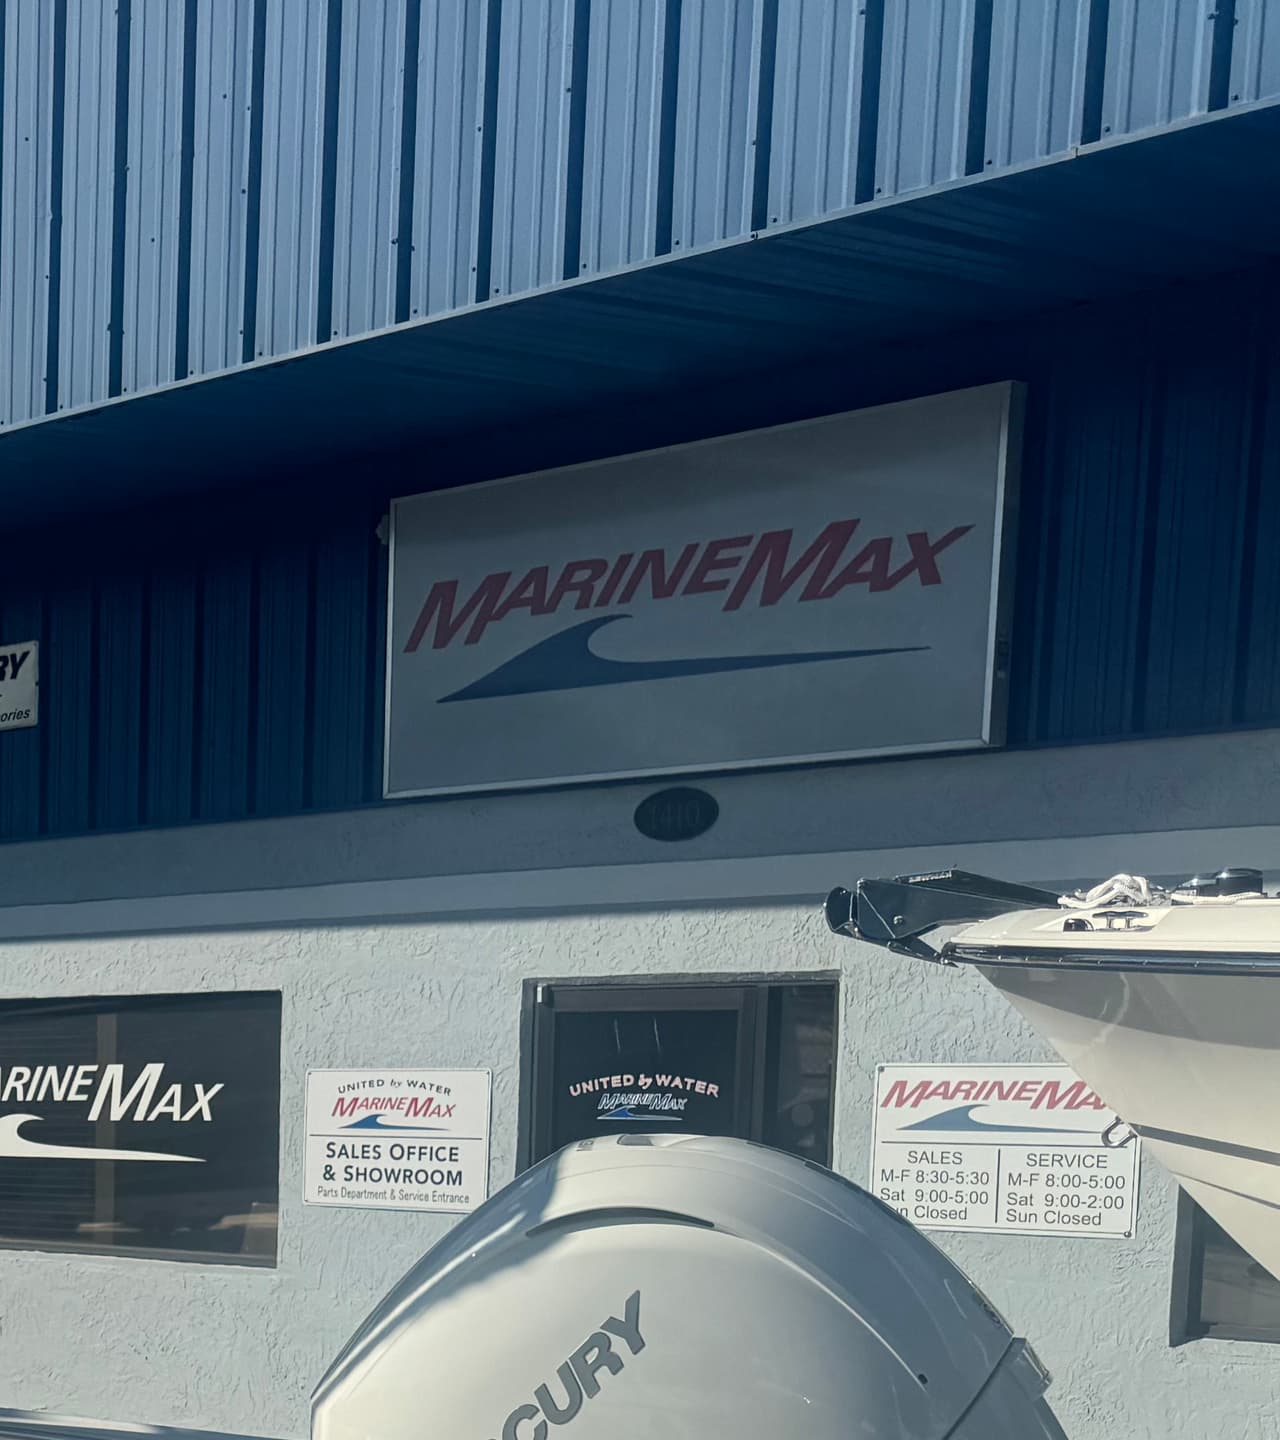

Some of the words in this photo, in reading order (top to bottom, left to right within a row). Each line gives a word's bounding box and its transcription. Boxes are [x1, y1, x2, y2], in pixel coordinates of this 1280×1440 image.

[404, 518, 975, 653] MARINEMAX
[338, 1079, 385, 1094] UNITED
[390, 1079, 402, 1088] by
[407, 1079, 451, 1096] WATER
[569, 1074, 634, 1097] UNITED
[638, 1074, 653, 1090] by
[656, 1074, 720, 1098] WATER
[880, 1080, 1107, 1110] MARINEMA
[332, 1097, 456, 1117] MARINEMAX
[326, 1142, 381, 1160] SALES
[390, 1143, 459, 1162] OFFICE
[907, 1150, 963, 1165] SALES
[1026, 1153, 1108, 1169] SERVICE
[323, 1164, 335, 1181] &
[344, 1165, 462, 1186] SHOWROOM
[880, 1169, 910, 1182] M-F
[915, 1169, 989, 1185] 8:30-5:30
[1007, 1173, 1040, 1187] M-F
[1045, 1174, 1126, 1190] 8:00-5:00
[317, 1186, 338, 1198] Parts
[341, 1187, 387, 1200] Department
[399, 1189, 429, 1202] Service
[432, 1190, 470, 1204] Entrance
[880, 1188, 905, 1202] Sat
[915, 1188, 989, 1205] 9:00-5:00
[1007, 1192, 1034, 1207] Sat
[1044, 1193, 1124, 1210] 9:00-2:00
[914, 1205, 968, 1221] Closed
[1006, 1208, 1037, 1224] Sun
[1044, 1209, 1102, 1226] Closed
